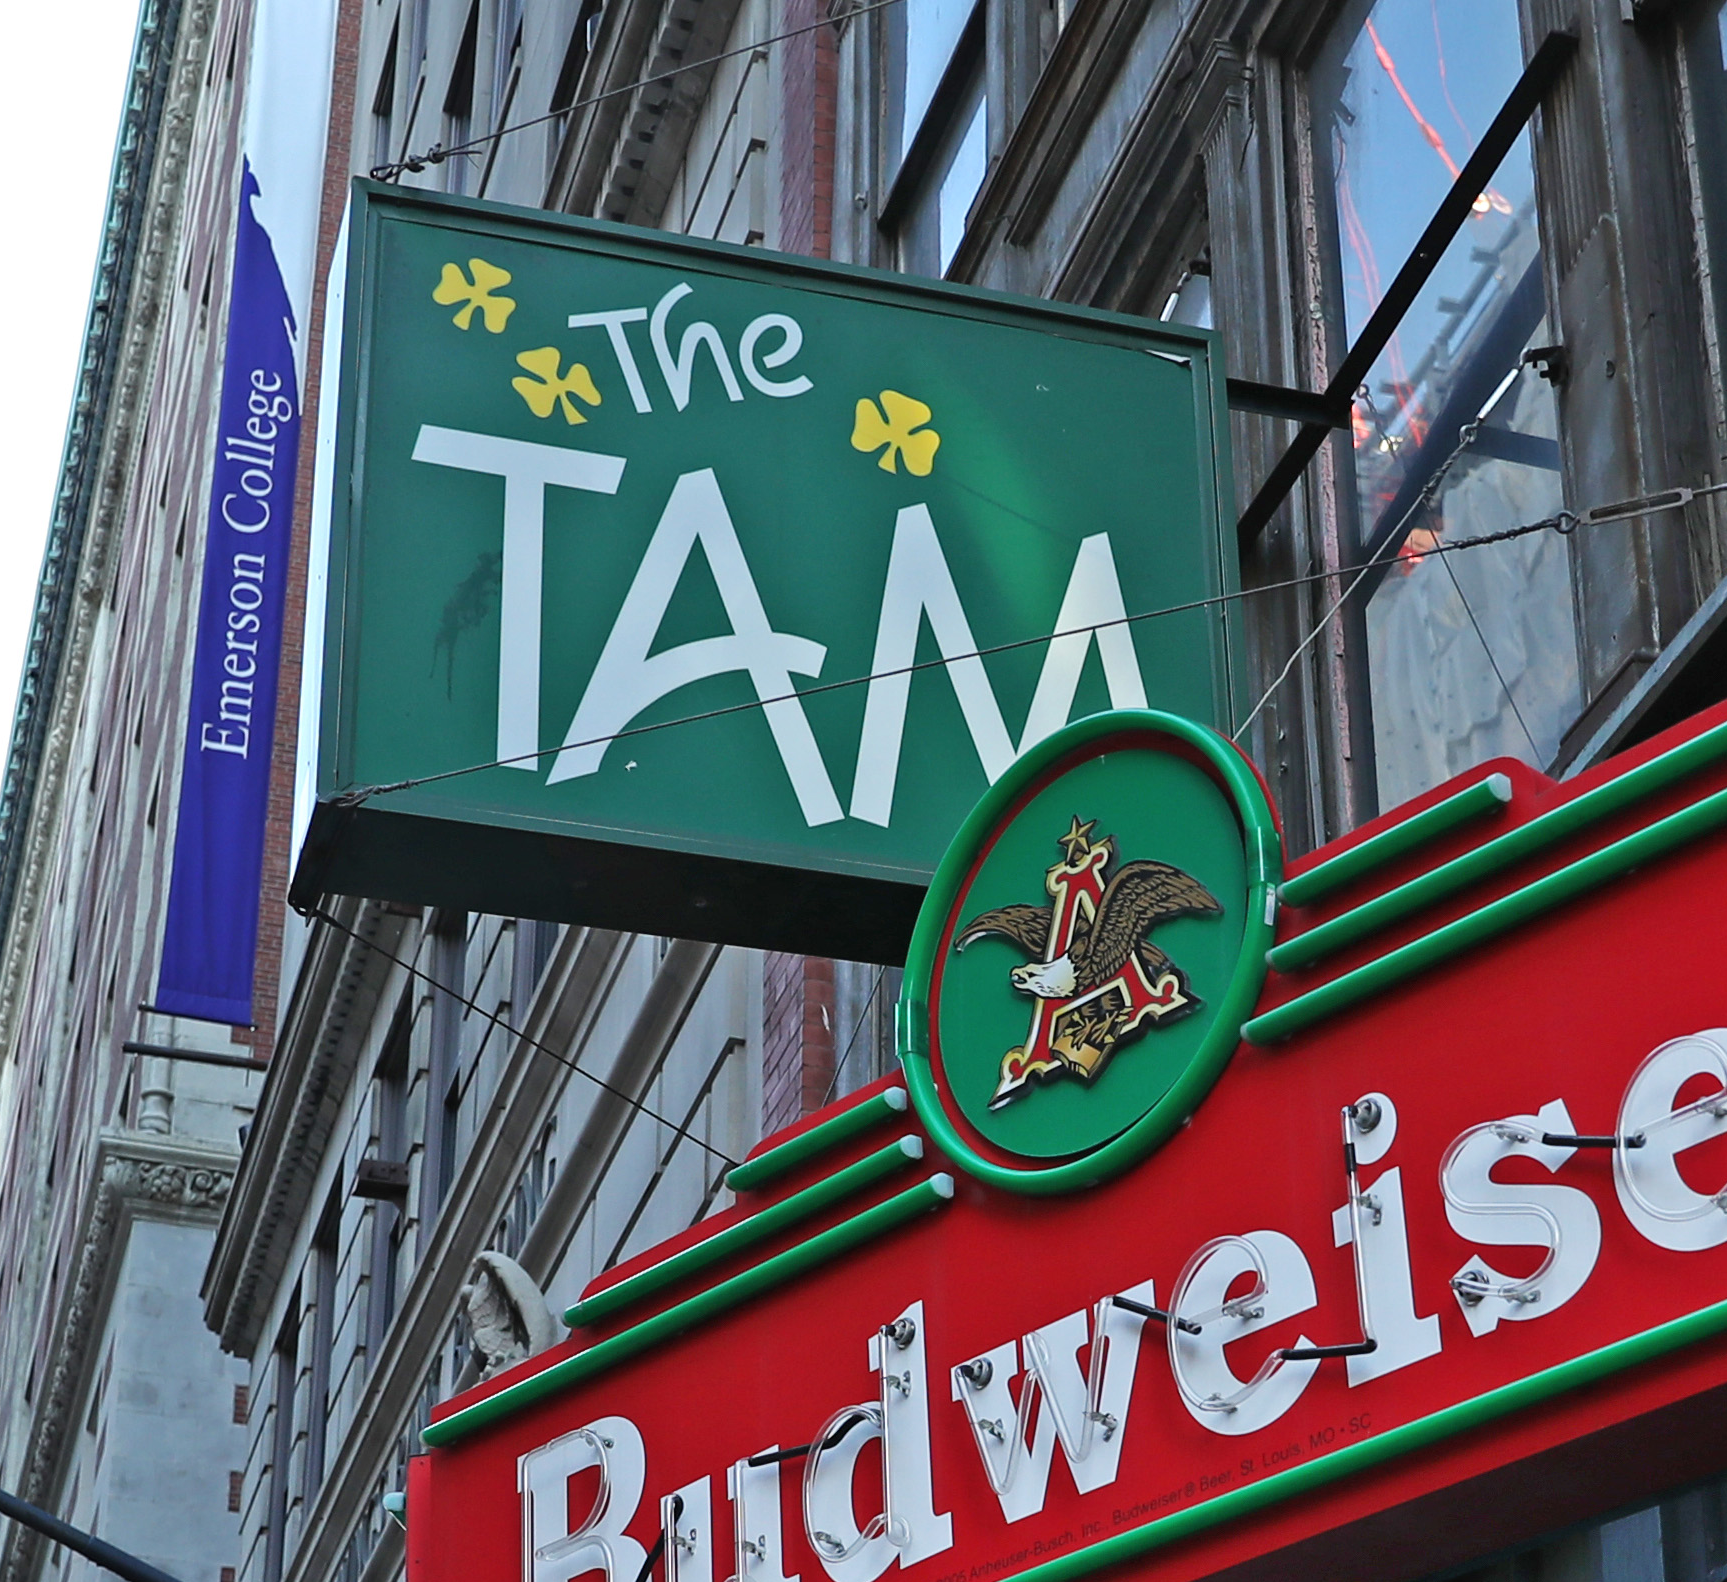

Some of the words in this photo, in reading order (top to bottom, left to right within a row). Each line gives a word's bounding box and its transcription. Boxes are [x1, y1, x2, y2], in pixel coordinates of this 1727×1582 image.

[568, 282, 814, 414] The
[222, 369, 293, 534] College
[201, 552, 266, 760] Emerson
[411, 423, 1149, 837] TAM
[1310, 1427, 1335, 1448] MO
[1349, 1413, 1372, 1433] SC
